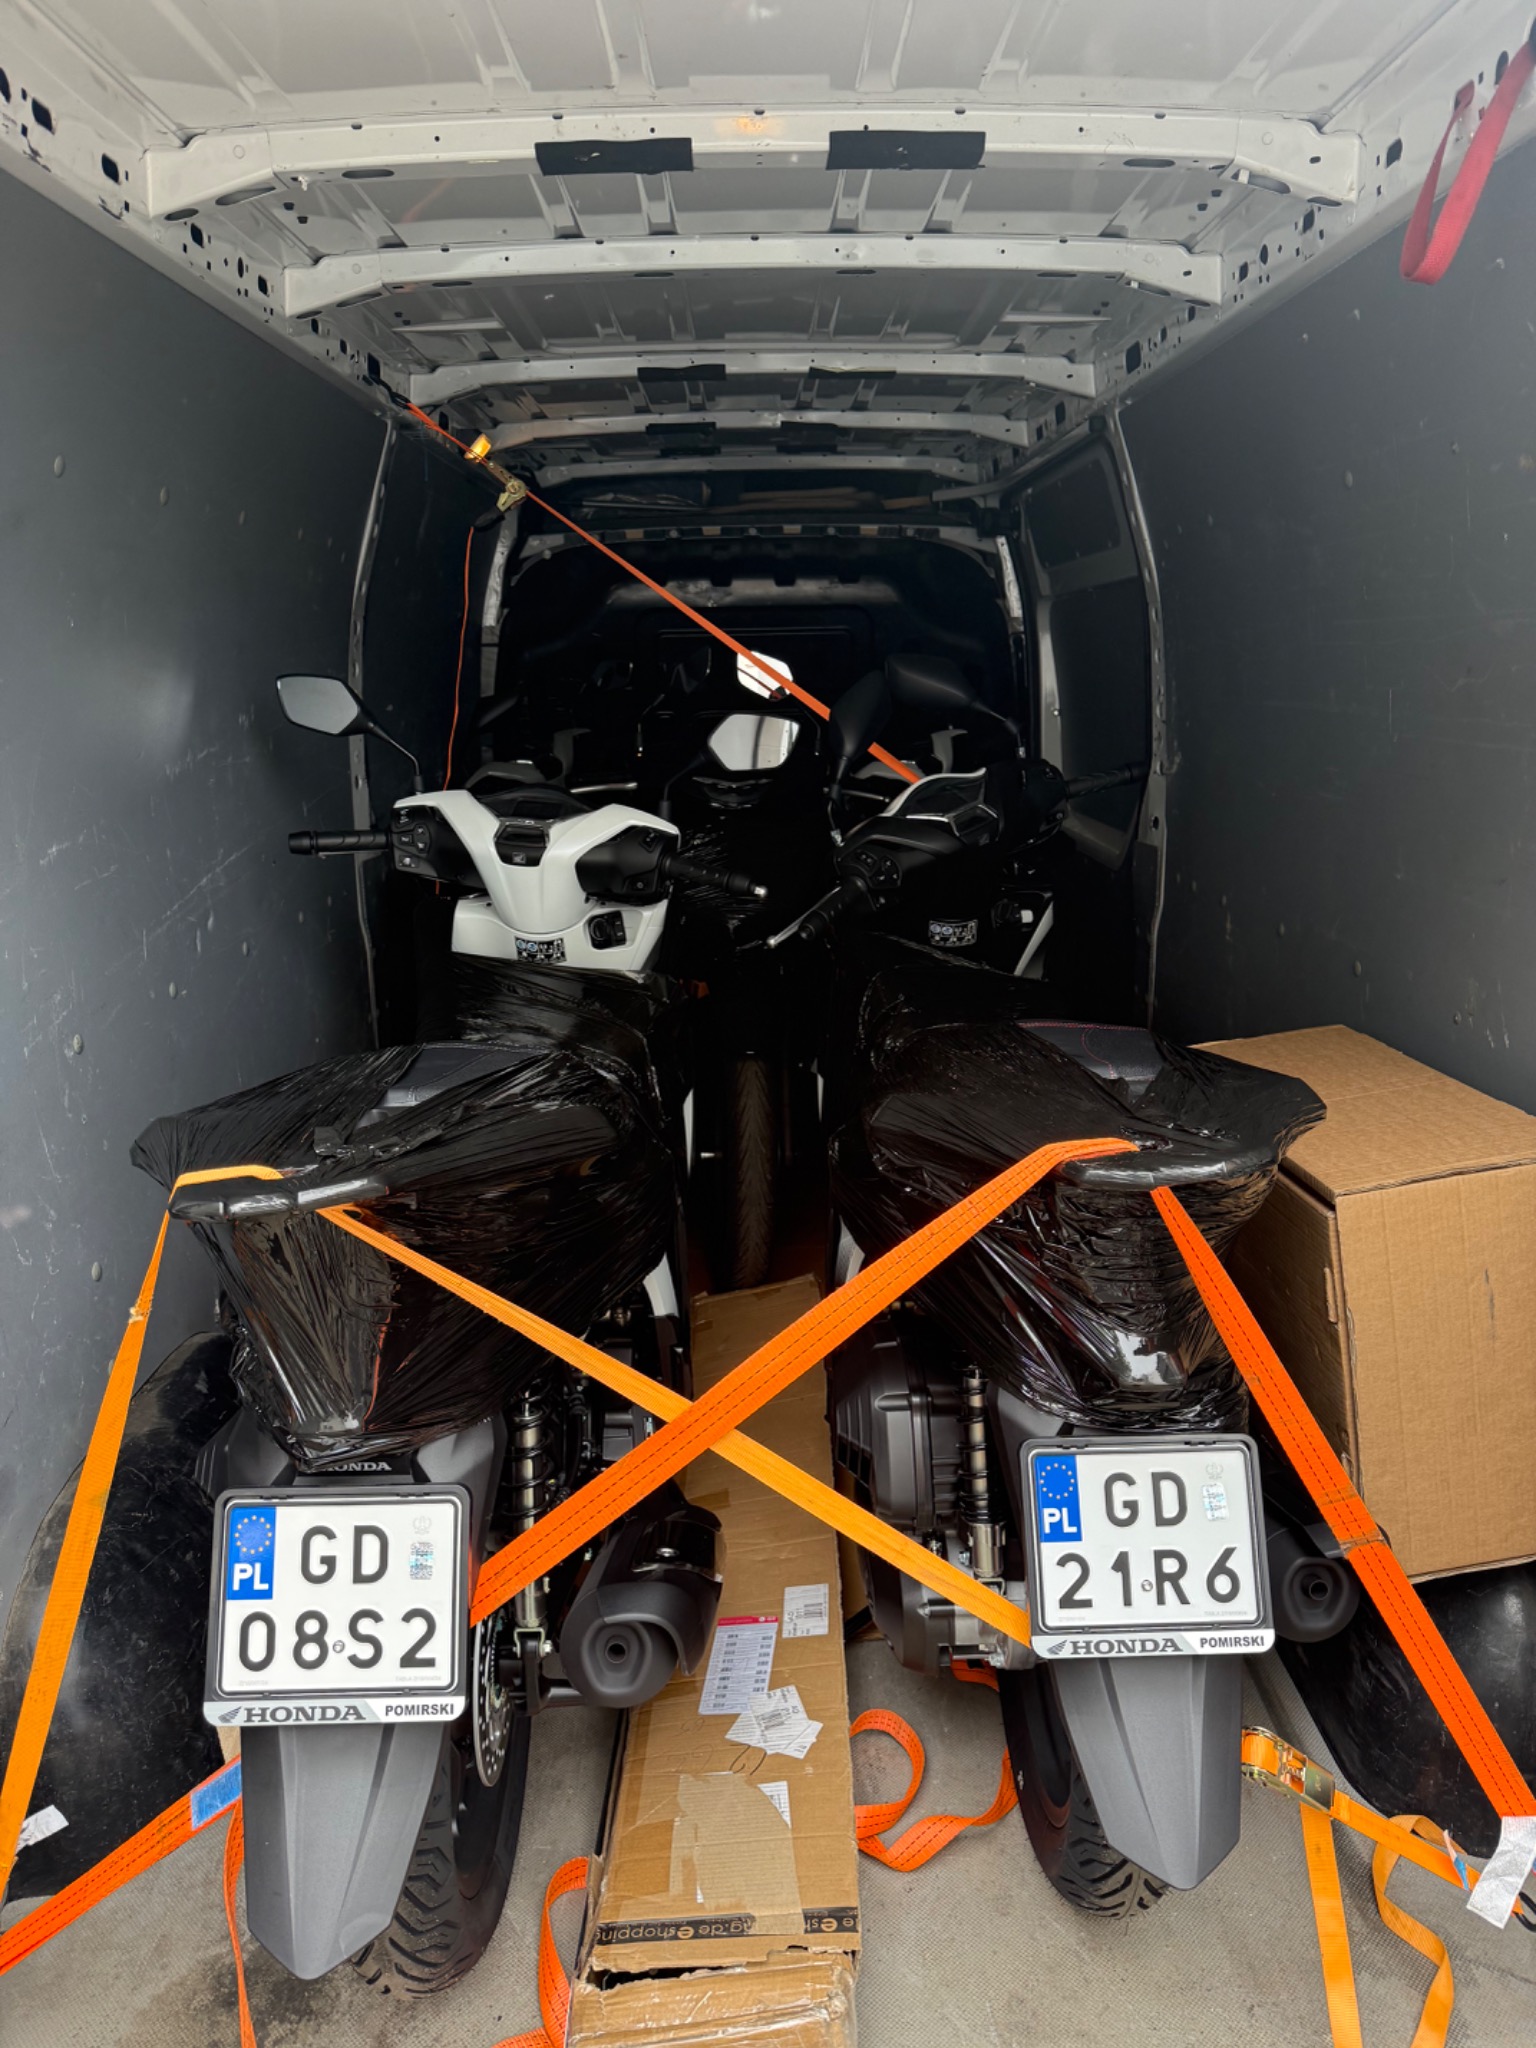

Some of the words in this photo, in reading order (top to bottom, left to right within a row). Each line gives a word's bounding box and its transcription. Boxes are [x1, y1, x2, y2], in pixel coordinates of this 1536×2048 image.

[324, 1461, 392, 1471] ONDA
[1104, 1471, 1189, 1528] GD
[1043, 1507, 1078, 1535] PL
[301, 1525, 389, 1585] GD
[233, 1563, 269, 1591] PL
[1056, 1546, 1241, 1609] 21R6
[239, 1608, 437, 1672] 08S2
[1070, 1639, 1183, 1655] HONDA
[1200, 1636, 1265, 1648] POMIRSKI
[244, 1705, 366, 1723] HONDA
[385, 1703, 455, 1717] POMIRSKI
